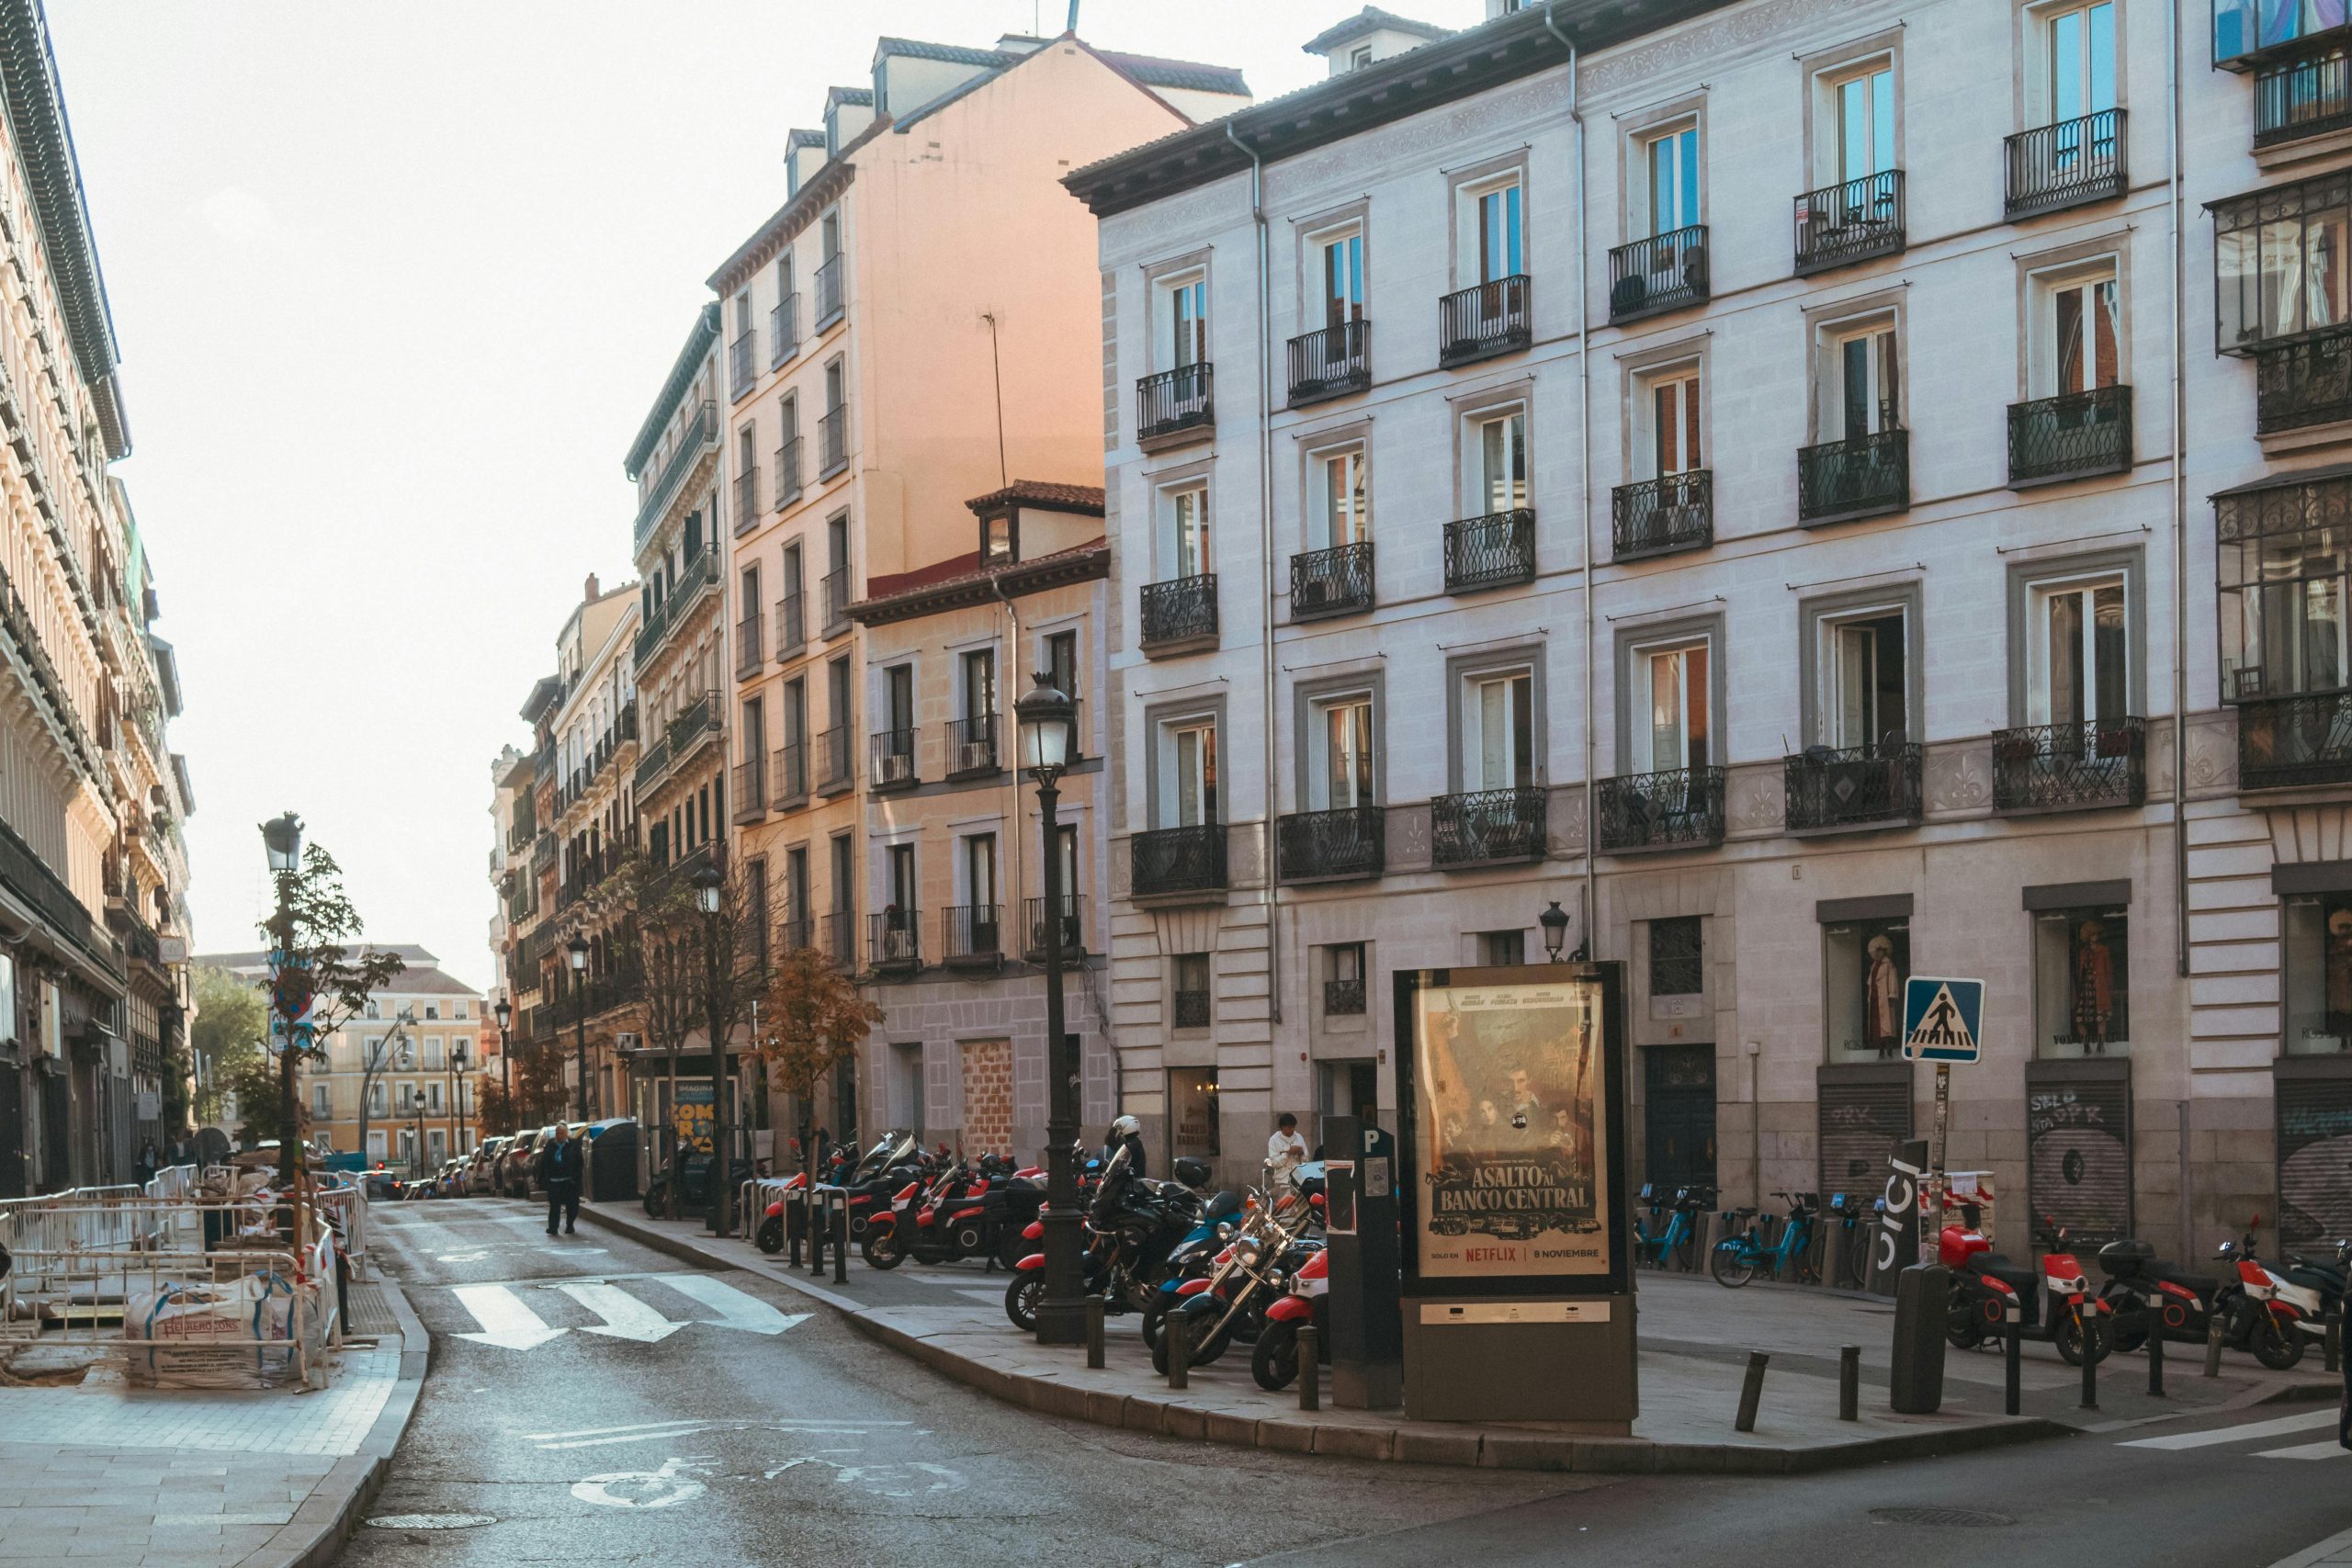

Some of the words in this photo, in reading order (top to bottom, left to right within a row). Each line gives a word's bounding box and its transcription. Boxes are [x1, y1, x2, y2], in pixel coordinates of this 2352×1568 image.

[2053, 1034, 2073, 1044] VOX
[1364, 1130, 1380, 1153] P
[1472, 1166, 1543, 1188] ASALTO
[1543, 1174, 1555, 1187] AL
[1441, 1190, 1502, 1211] BANCO
[1504, 1188, 1589, 1209] CENTRAL
[1466, 1247, 1516, 1262] NETFLIX
[1534, 1250, 1542, 1258] 8
[1543, 1248, 1600, 1258] NOVIEMBRE
